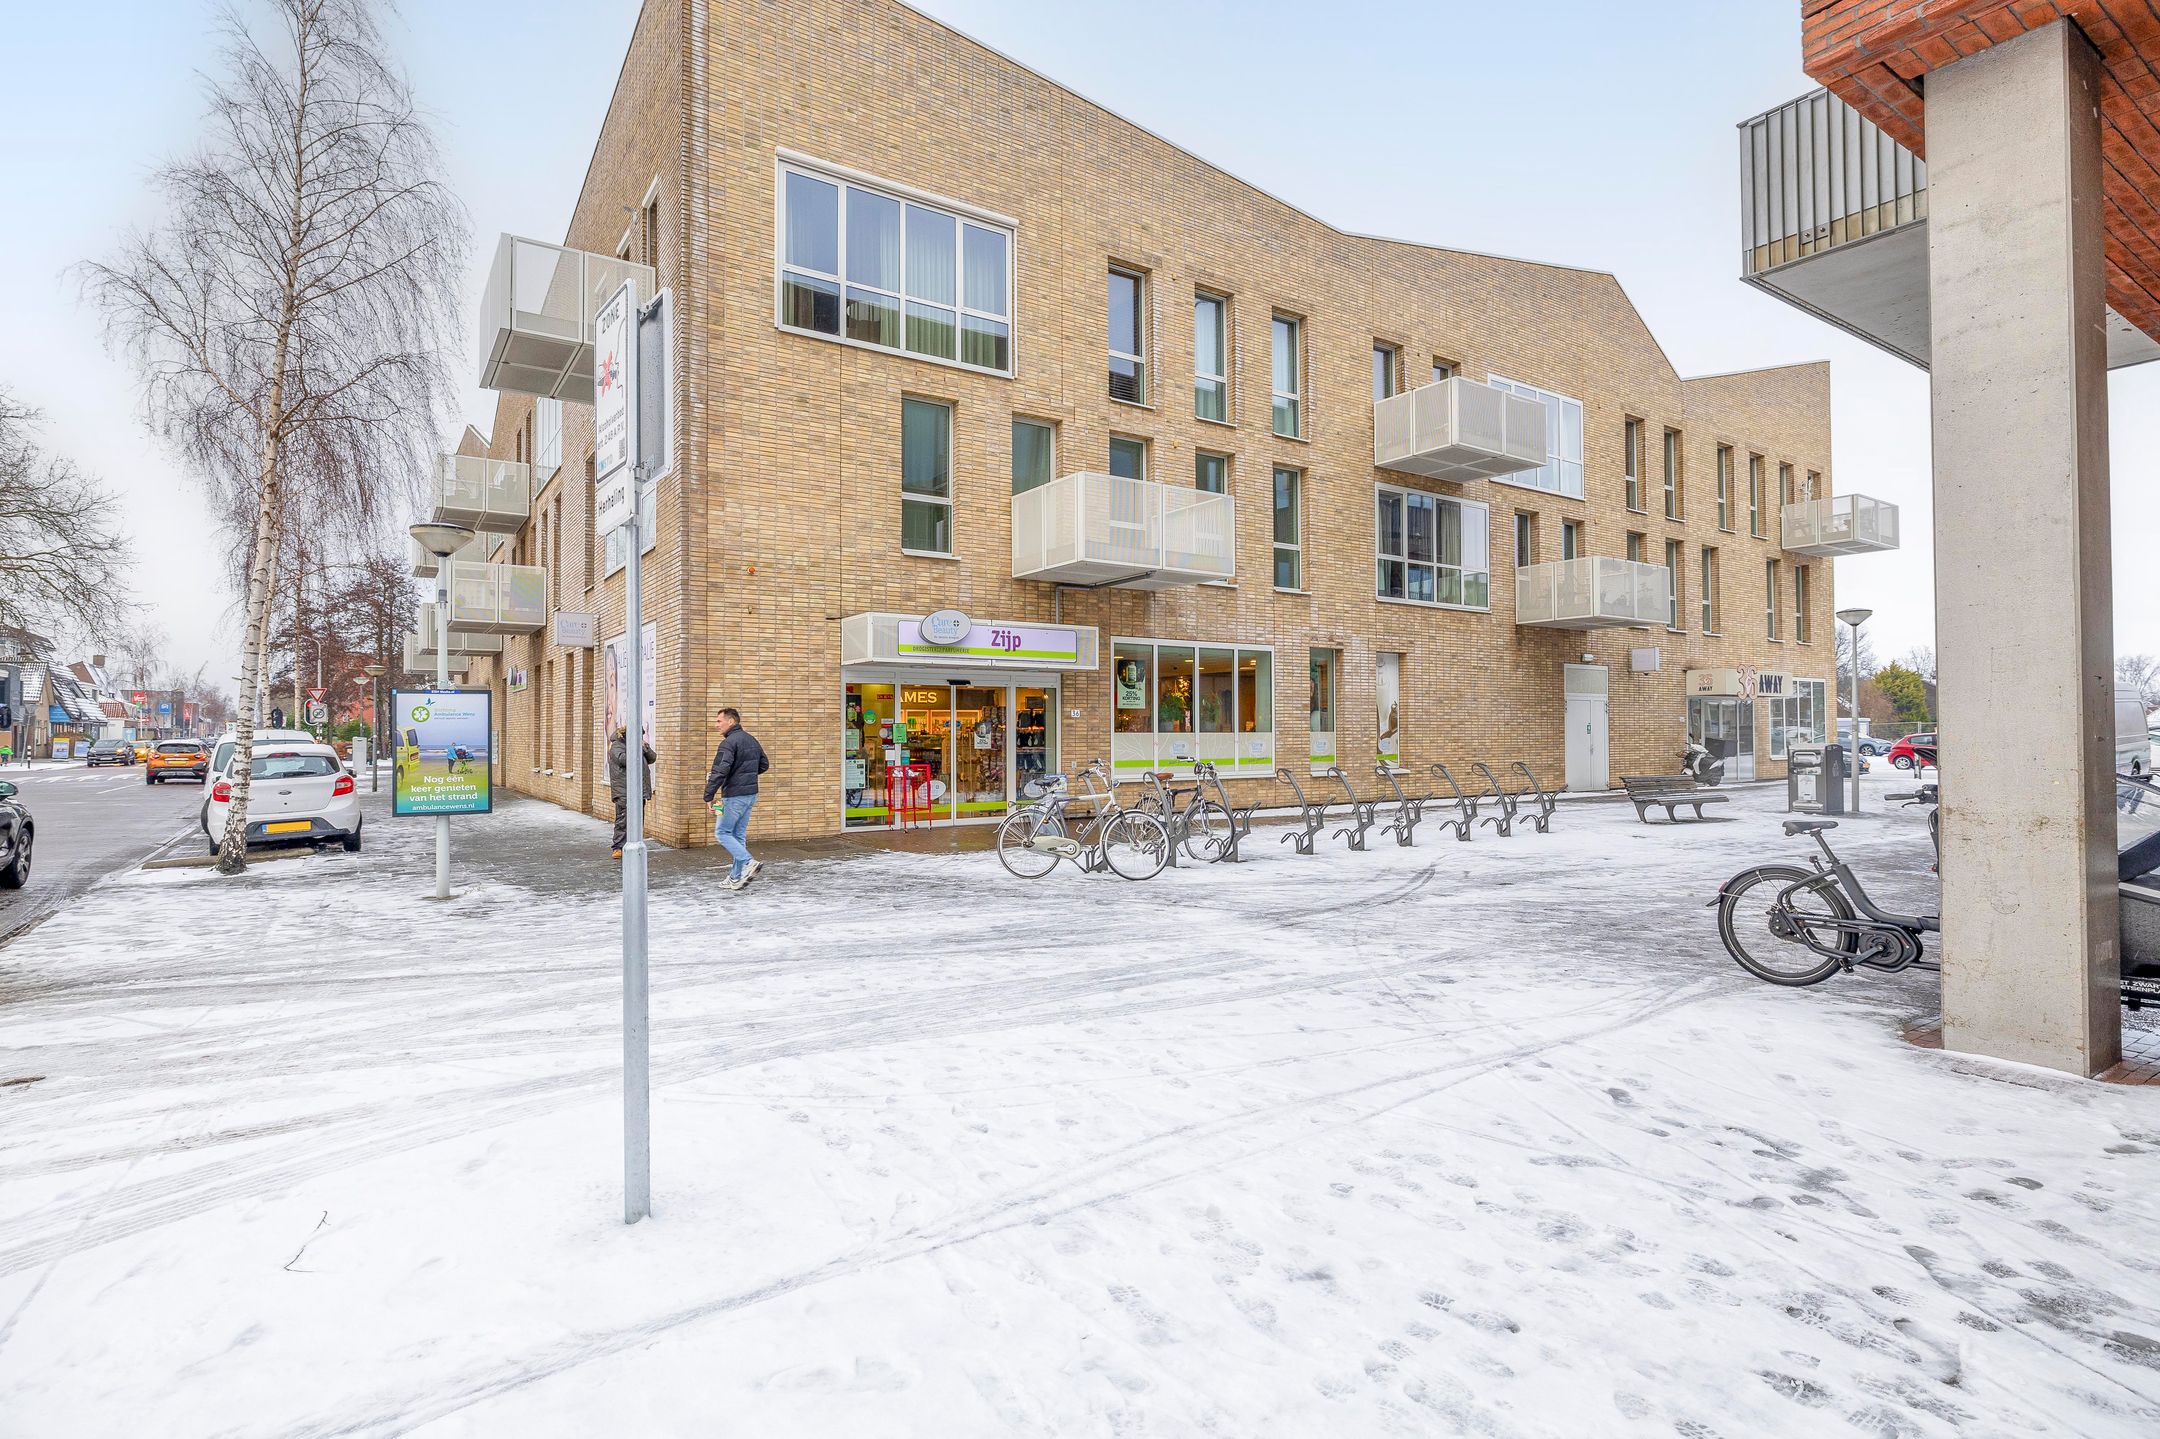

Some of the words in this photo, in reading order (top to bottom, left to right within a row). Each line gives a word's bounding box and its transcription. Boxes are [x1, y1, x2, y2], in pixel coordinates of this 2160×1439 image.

[602, 302, 620, 334] ZONE
[598, 486, 625, 517] Herhaling
[932, 624, 959, 636] Beauty
[991, 630, 1022, 652] Zijp
[1737, 664, 1758, 700] 36
[1759, 674, 1783, 694] AWAY
[424, 776, 444, 784] Nog
[411, 785, 431, 793] keer
[434, 784, 476, 793] genieten
[448, 792, 478, 800] strand
[412, 803, 475, 811] ambulancewens.nl
[2132, 981, 2160, 989] ZWAR
